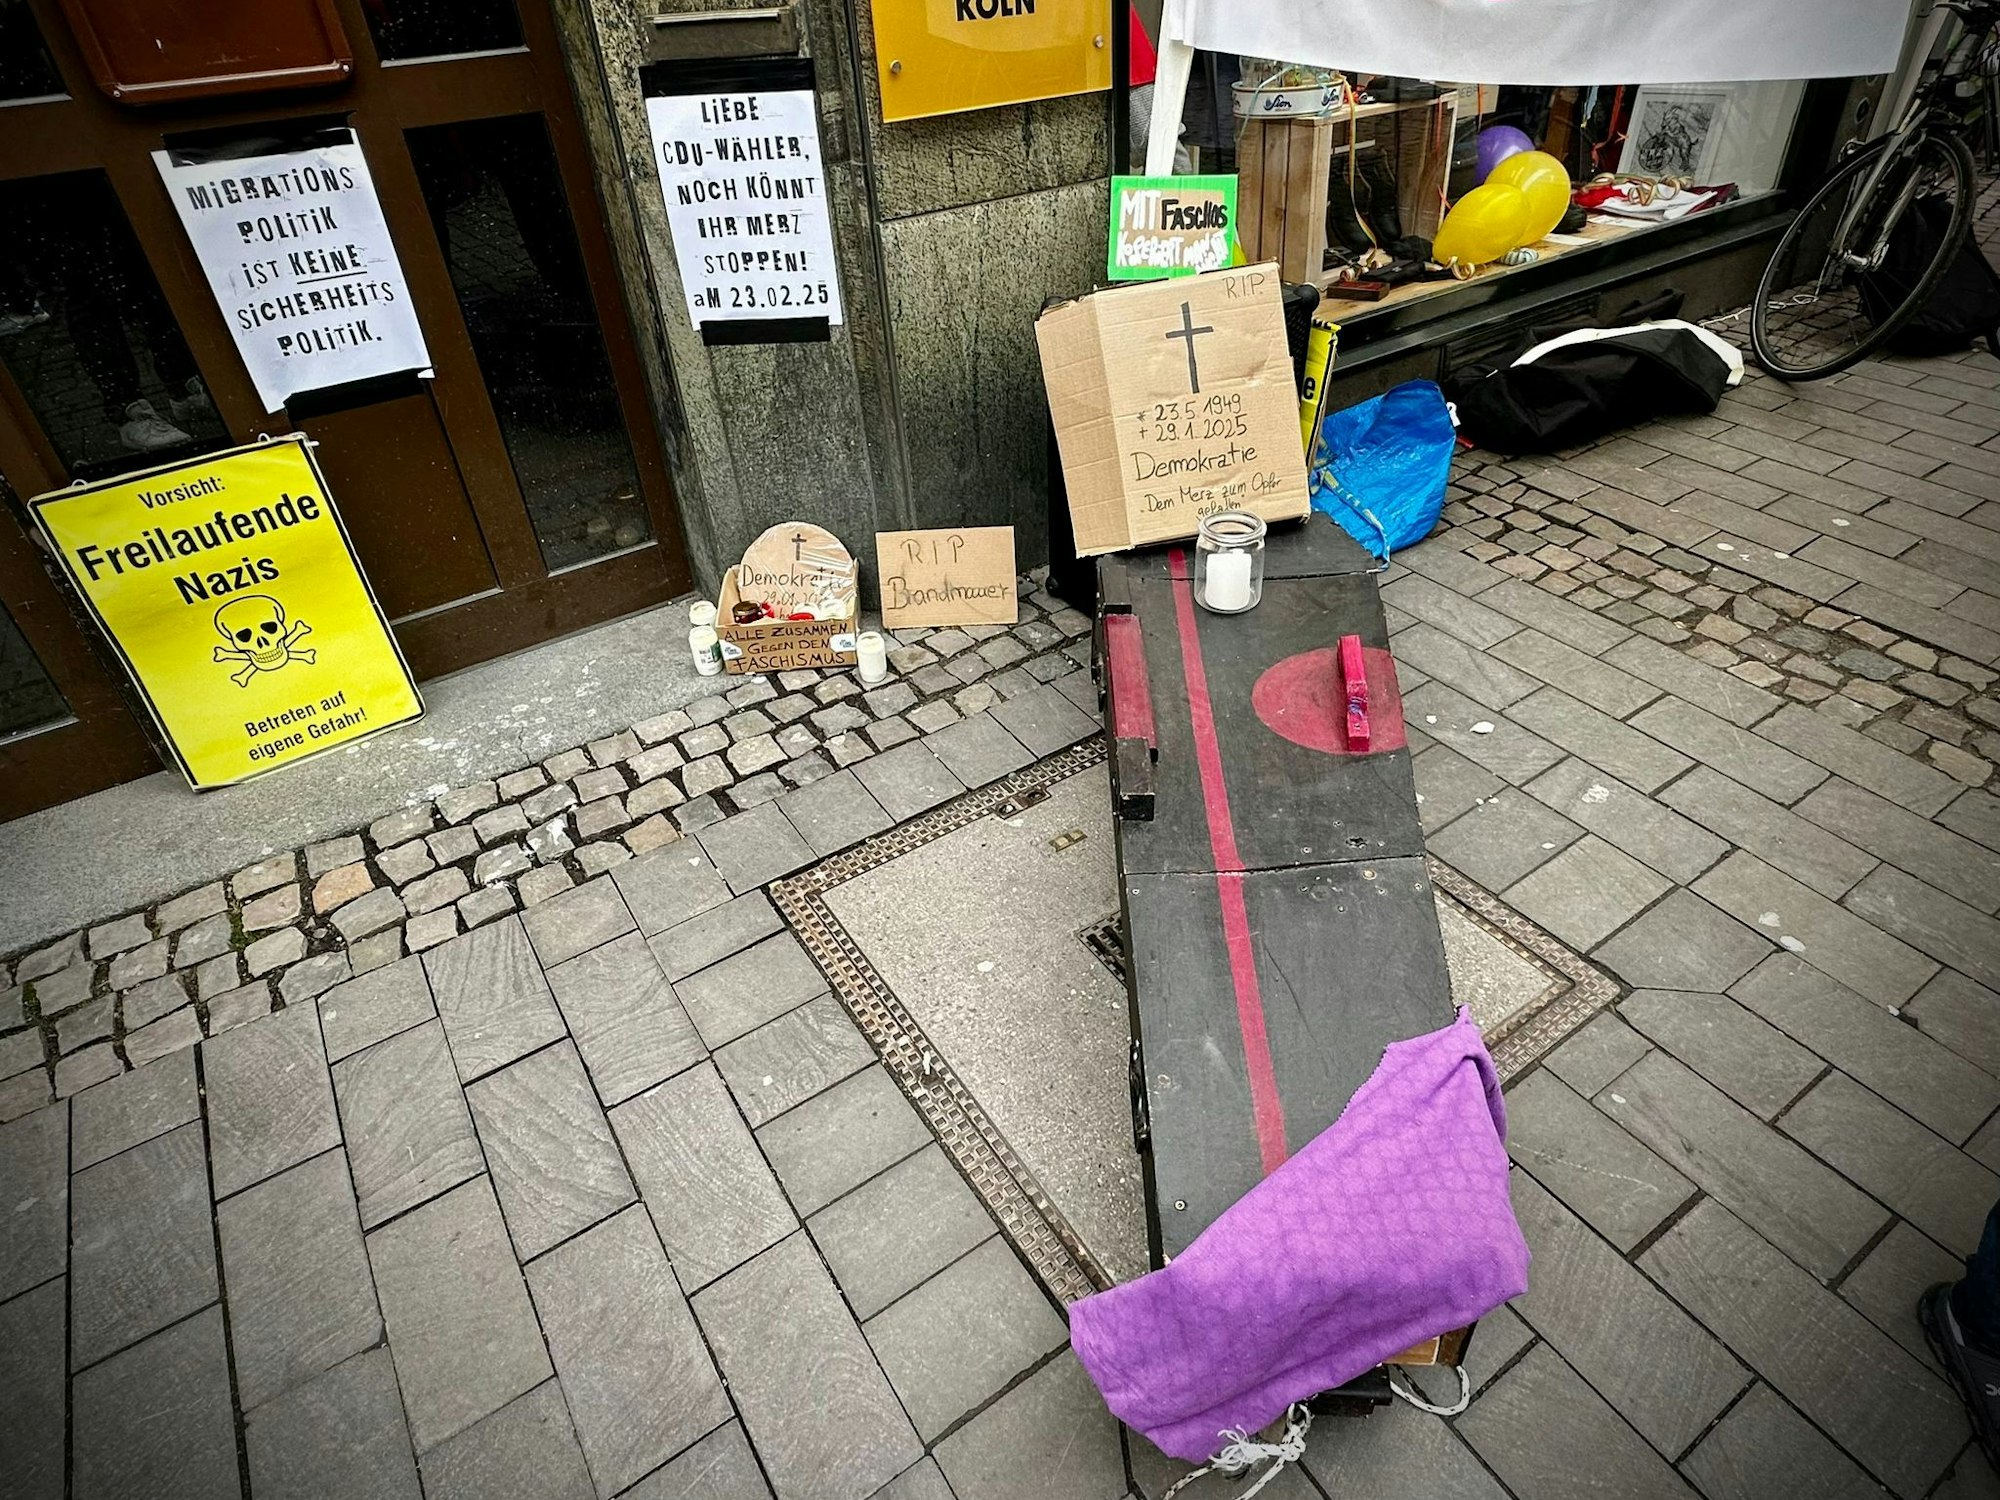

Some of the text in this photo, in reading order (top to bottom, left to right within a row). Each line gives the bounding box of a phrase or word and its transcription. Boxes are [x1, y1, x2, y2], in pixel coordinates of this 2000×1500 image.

[662, 135, 810, 167] CDU-WÄHLER,
[677, 172, 816, 206] NOCH KÖNNT
[697, 212, 802, 238] IHR MERZ
[1120, 190, 1161, 230] MIT
[704, 250, 807, 275] STOPPEN!
[730, 282, 829, 309] 23.02.25
[1130, 442, 1258, 482] Demokratie
[138, 475, 227, 511] Vorsicht:
[1144, 472, 1282, 513] Dem Merz zum Opfer
[76, 491, 321, 581] Freilaufende
[174, 555, 280, 605] Nazis
[887, 576, 1009, 611] Brandmauer
[724, 622, 848, 642] ALLE ZUSAMMEN
[747, 642, 794, 655] GEGEN
[798, 638, 830, 650] DEN
[733, 653, 846, 672] FASCHISMUS
[244, 690, 348, 738] Betreten auf
[248, 706, 369, 763] eigene Gefahr!
